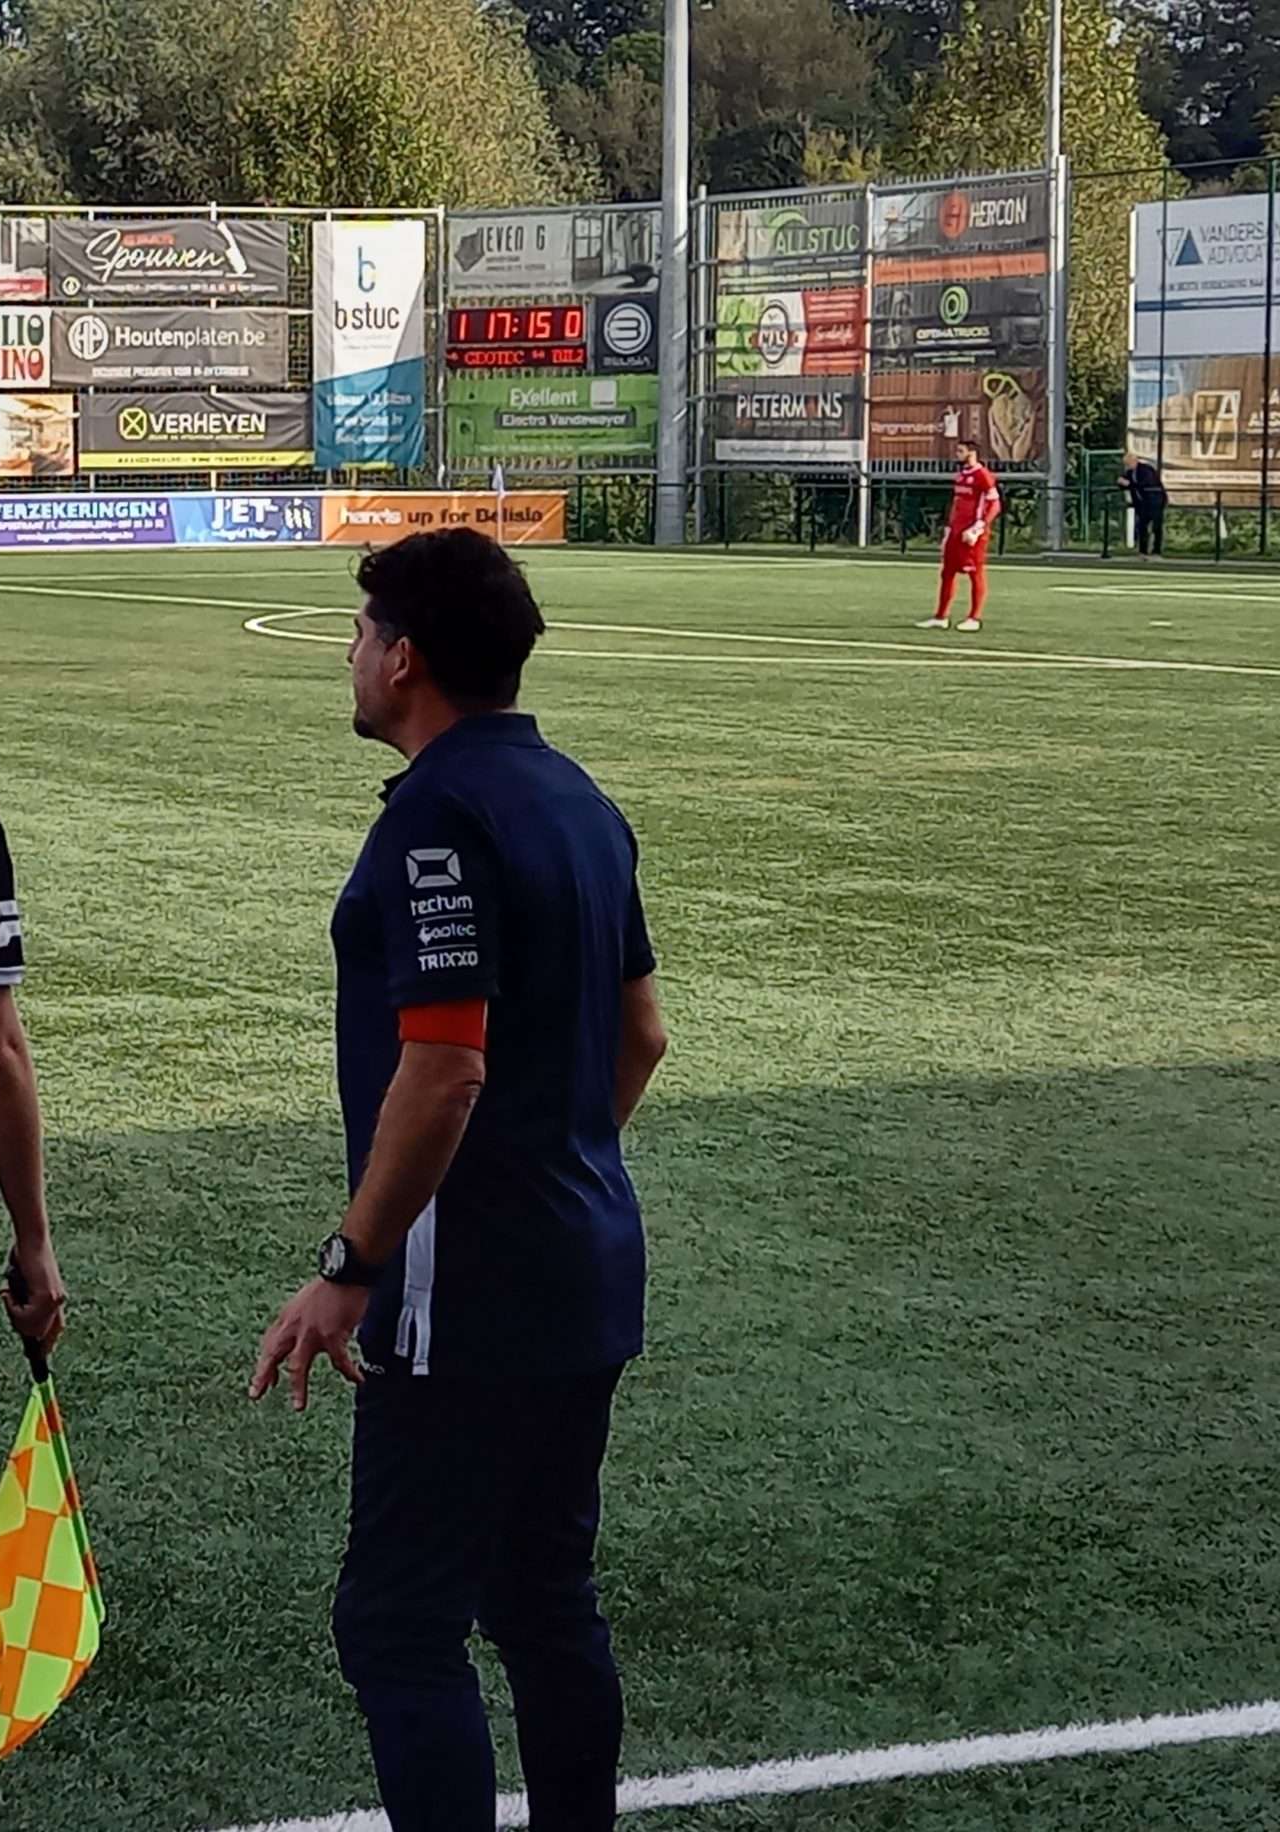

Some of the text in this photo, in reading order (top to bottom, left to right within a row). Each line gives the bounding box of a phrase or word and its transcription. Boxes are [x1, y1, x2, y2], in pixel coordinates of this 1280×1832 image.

[969, 196, 1027, 228] HERCON
[775, 223, 861, 256] ALLSTUC
[85, 228, 226, 283] Spouwen
[114, 326, 266, 349] Houtenplaten.be
[458, 313, 467, 341] 1
[564, 310, 582, 339] 0
[149, 412, 267, 434] VERHEYEN
[340, 508, 402, 525] hands
[407, 511, 434, 528] up
[440, 507, 469, 523] for
[417, 950, 479, 971] TRIXXO
